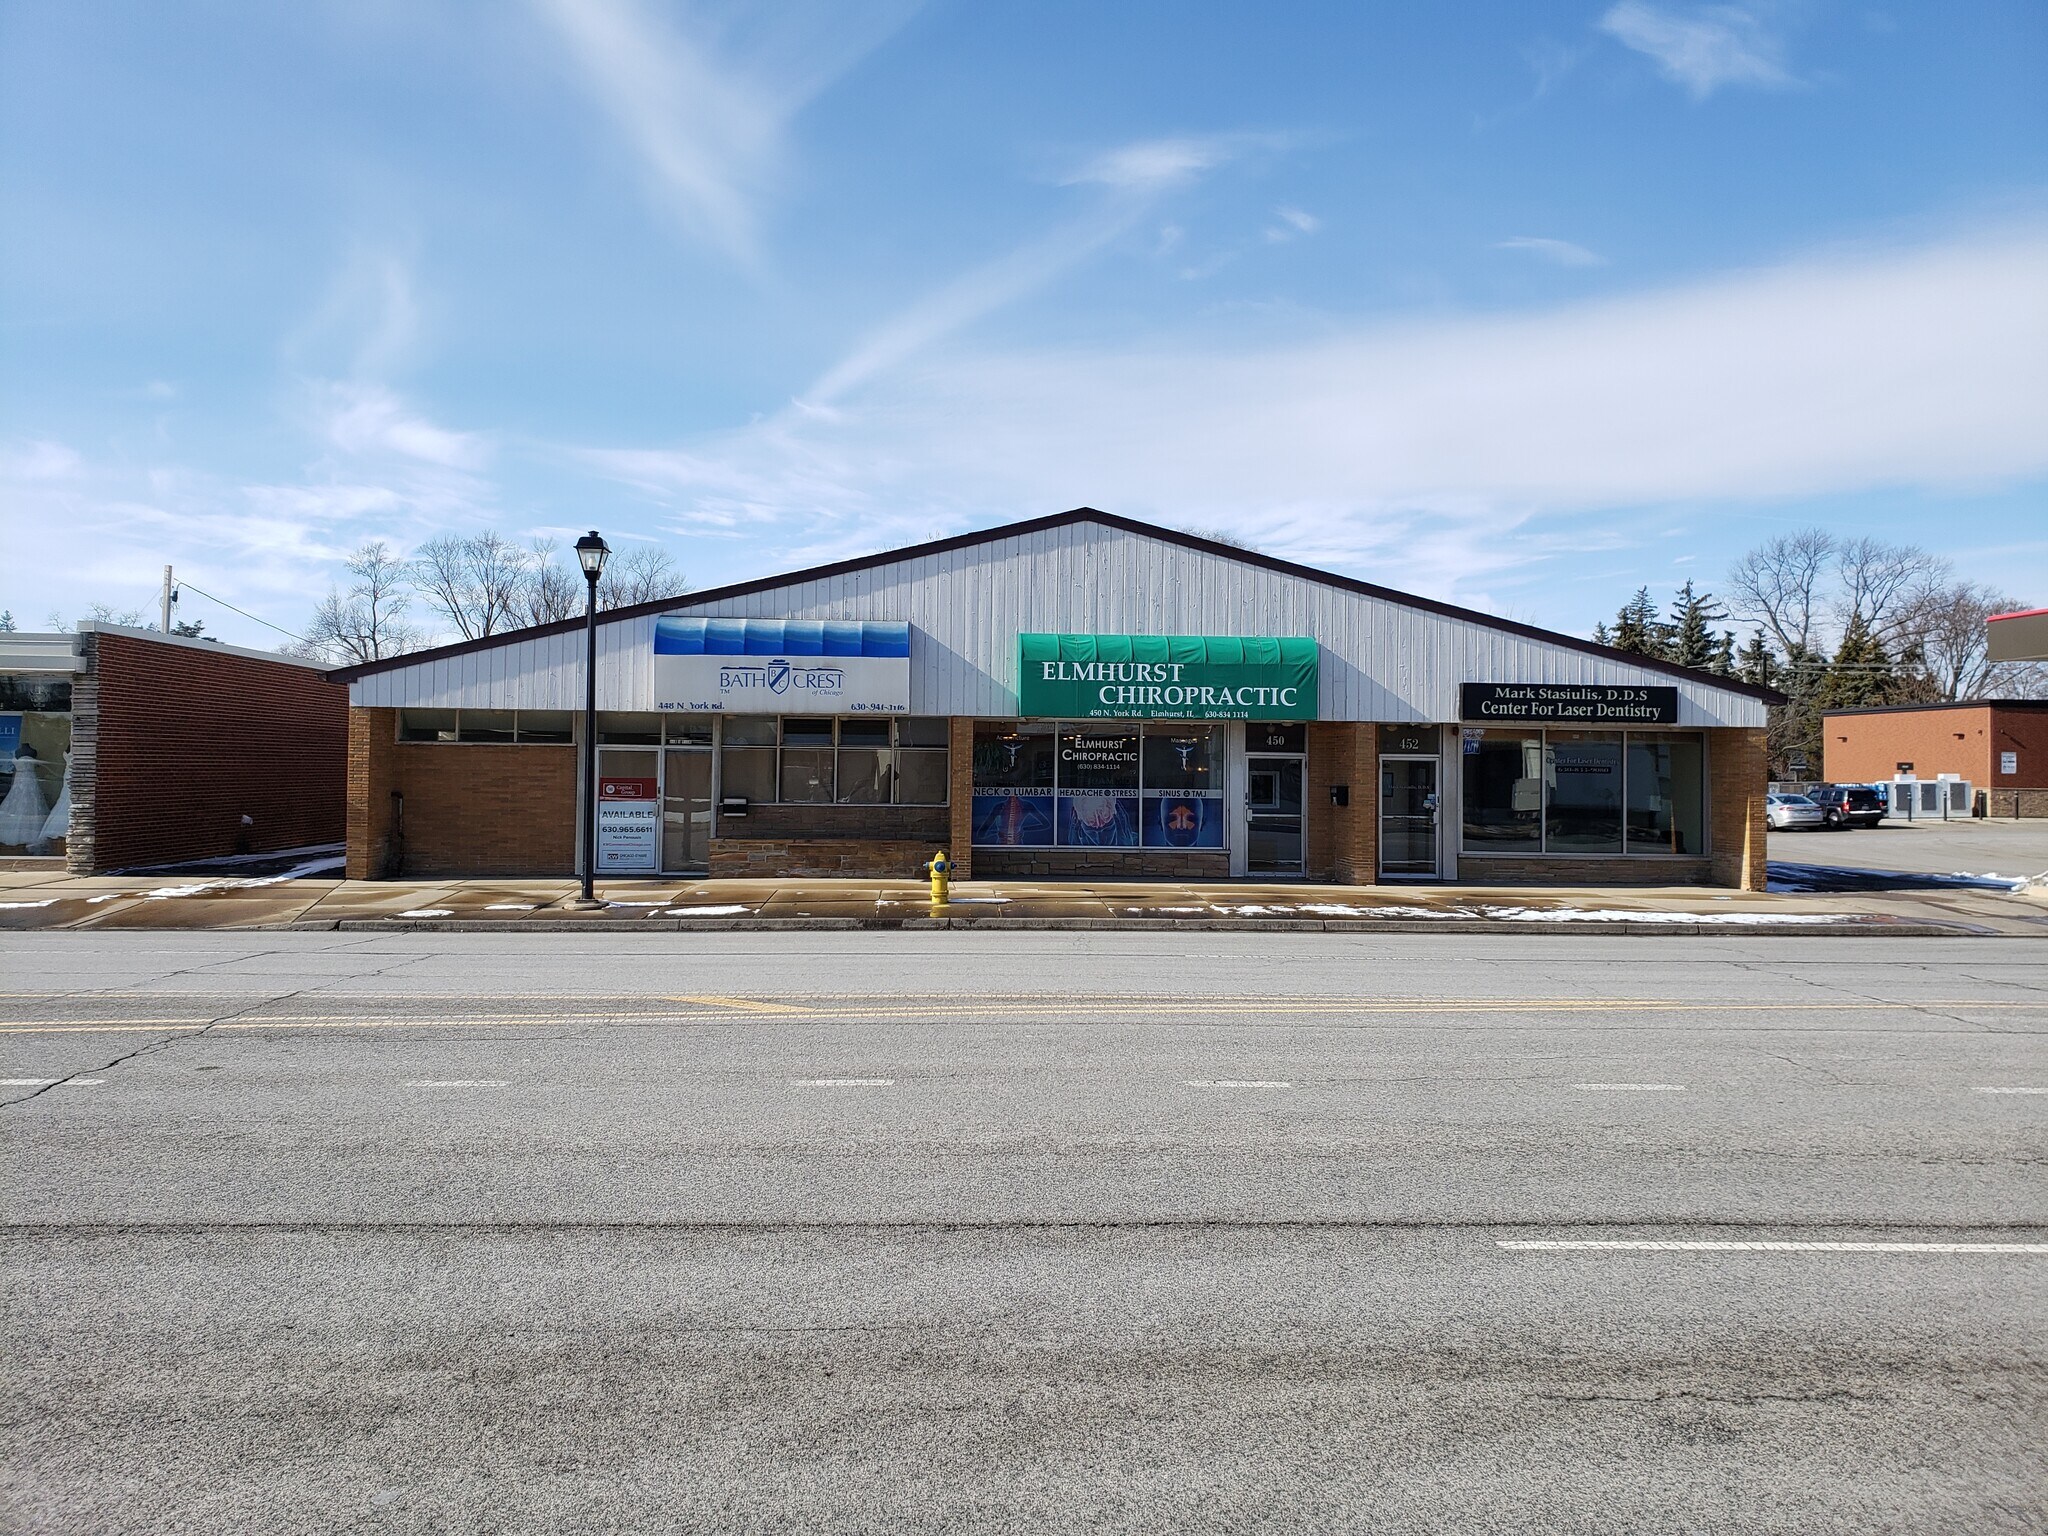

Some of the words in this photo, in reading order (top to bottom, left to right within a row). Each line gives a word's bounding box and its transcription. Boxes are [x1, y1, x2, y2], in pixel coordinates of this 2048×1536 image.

[1042, 661, 1184, 682] ELMHURST
[720, 672, 765, 688] BATH
[793, 673, 844, 689] CREST
[812, 689, 818, 697] of
[819, 689, 844, 697] Chicago
[1099, 685, 1297, 706] CHIROPRACTIC
[1495, 687, 1535, 699] Mark
[1538, 687, 1602, 700] Stasiulis,
[1606, 689, 1648, 701] D.D.S
[658, 702, 674, 710] 448
[689, 701, 709, 710] York
[1481, 700, 1528, 715] Center
[1531, 702, 1554, 716] For
[1557, 702, 1594, 716] Laser
[1596, 703, 1661, 720] Dentistry
[1150, 710, 1185, 719] Elmhurst,
[1075, 737, 1124, 749] ELMHURST
[1266, 735, 1285, 746] 450
[1399, 738, 1419, 749] 452
[1062, 749, 1138, 761] CHIROPRACTIC
[1077, 763, 1093, 771] (630)
[973, 787, 1000, 796] NECK
[1013, 787, 1052, 796] LUMBAR
[1059, 789, 1104, 797] HEADACHE
[1112, 789, 1137, 797] STRESS
[1158, 789, 1181, 797] SINUS
[1191, 790, 1207, 798] TMJ
[602, 811, 654, 819] AVAILABLE
